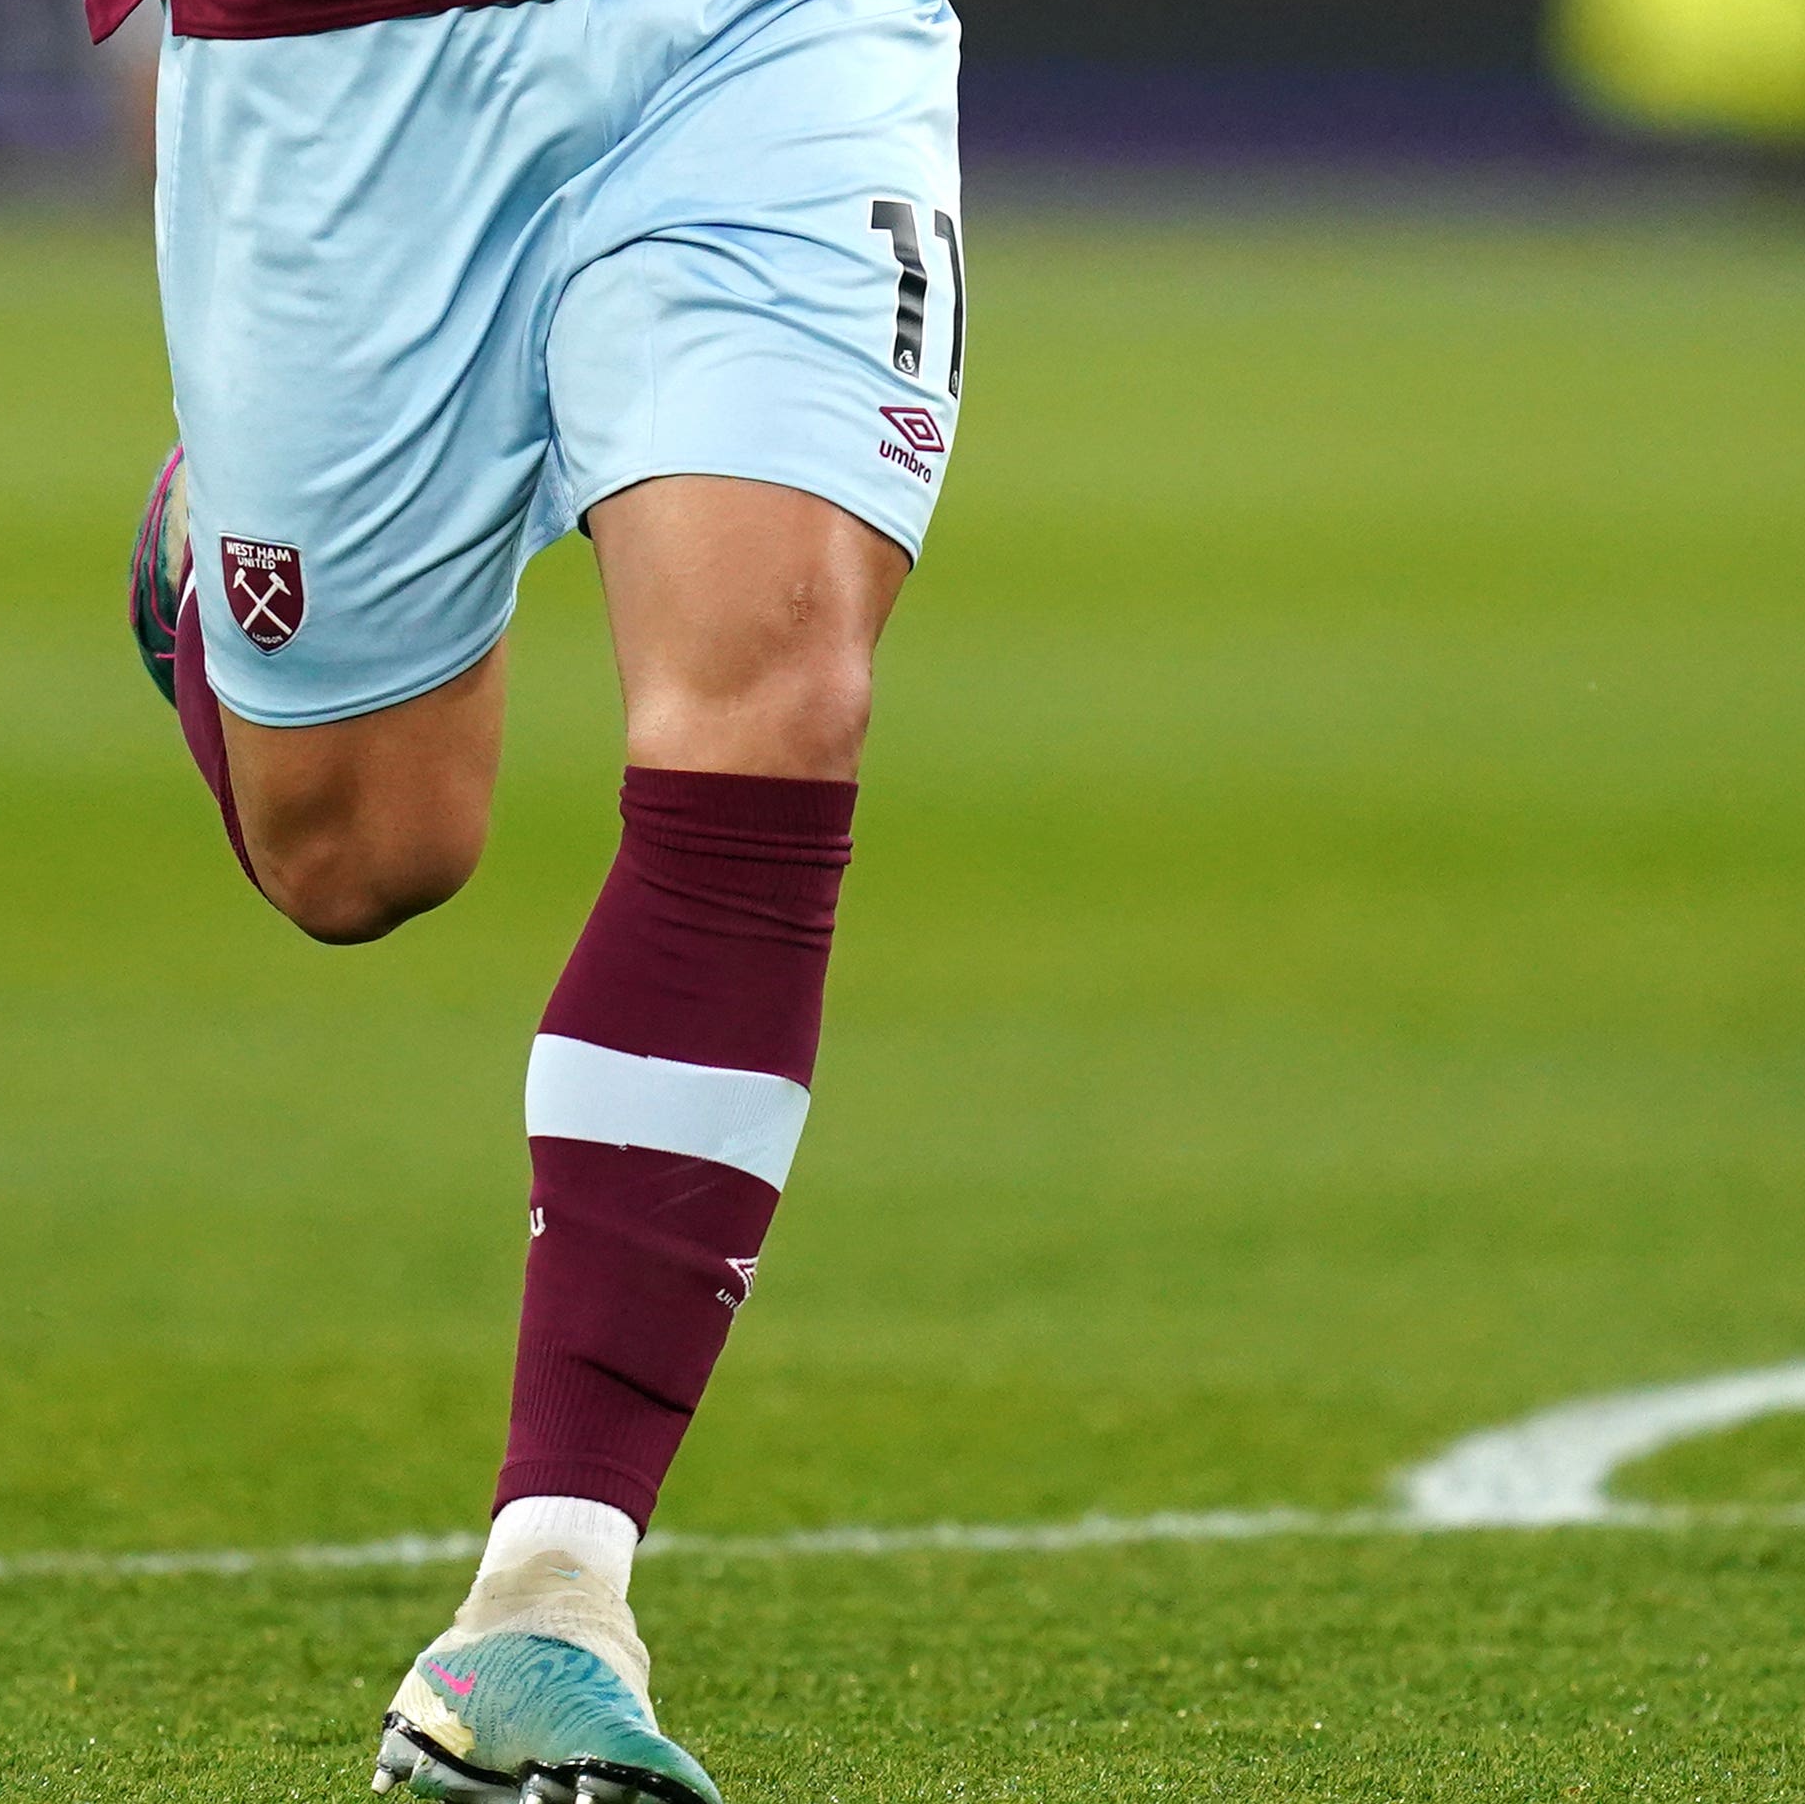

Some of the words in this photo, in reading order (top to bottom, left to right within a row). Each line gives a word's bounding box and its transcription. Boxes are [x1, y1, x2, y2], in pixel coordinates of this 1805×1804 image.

[870, 199, 964, 401] 11
[879, 438, 932, 485] umbro
[226, 540, 256, 557] WEST
[257, 546, 292, 563] HAM
[237, 556, 277, 571] UNITED
